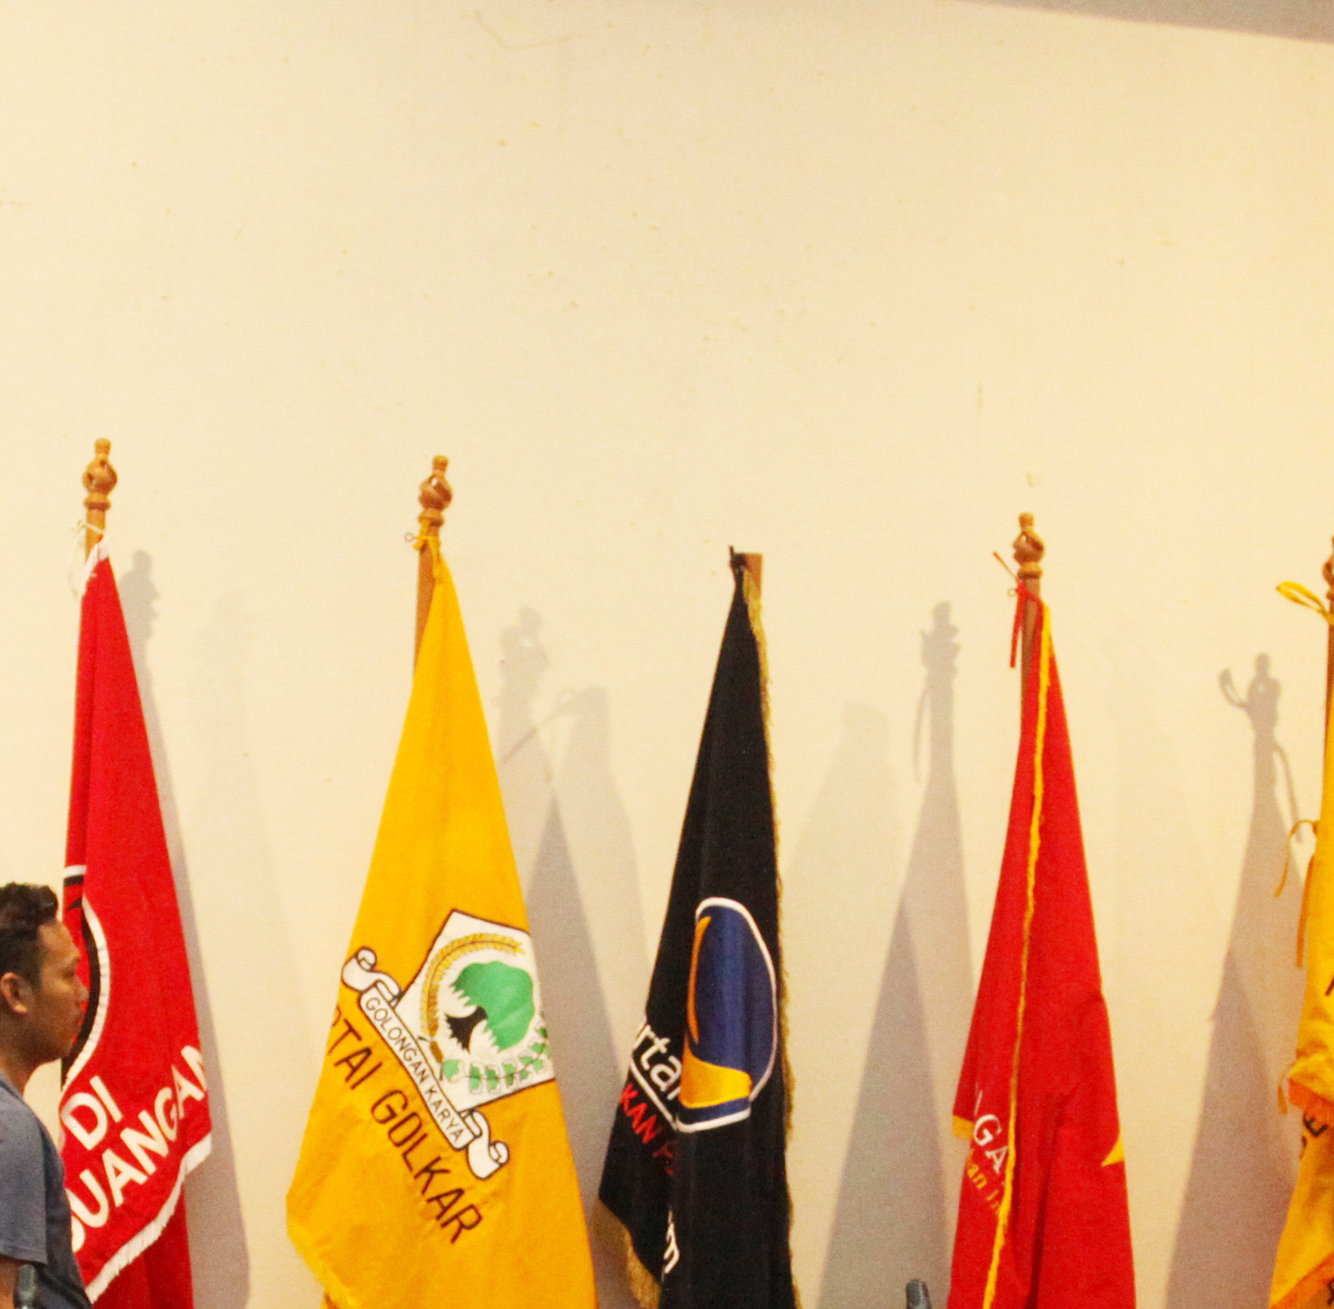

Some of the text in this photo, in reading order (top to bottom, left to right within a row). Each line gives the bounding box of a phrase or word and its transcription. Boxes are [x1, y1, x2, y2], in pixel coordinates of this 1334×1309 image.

[365, 996, 464, 1144] GOLONGAN KARYA
[370, 1089, 482, 1244] GOLKAR
